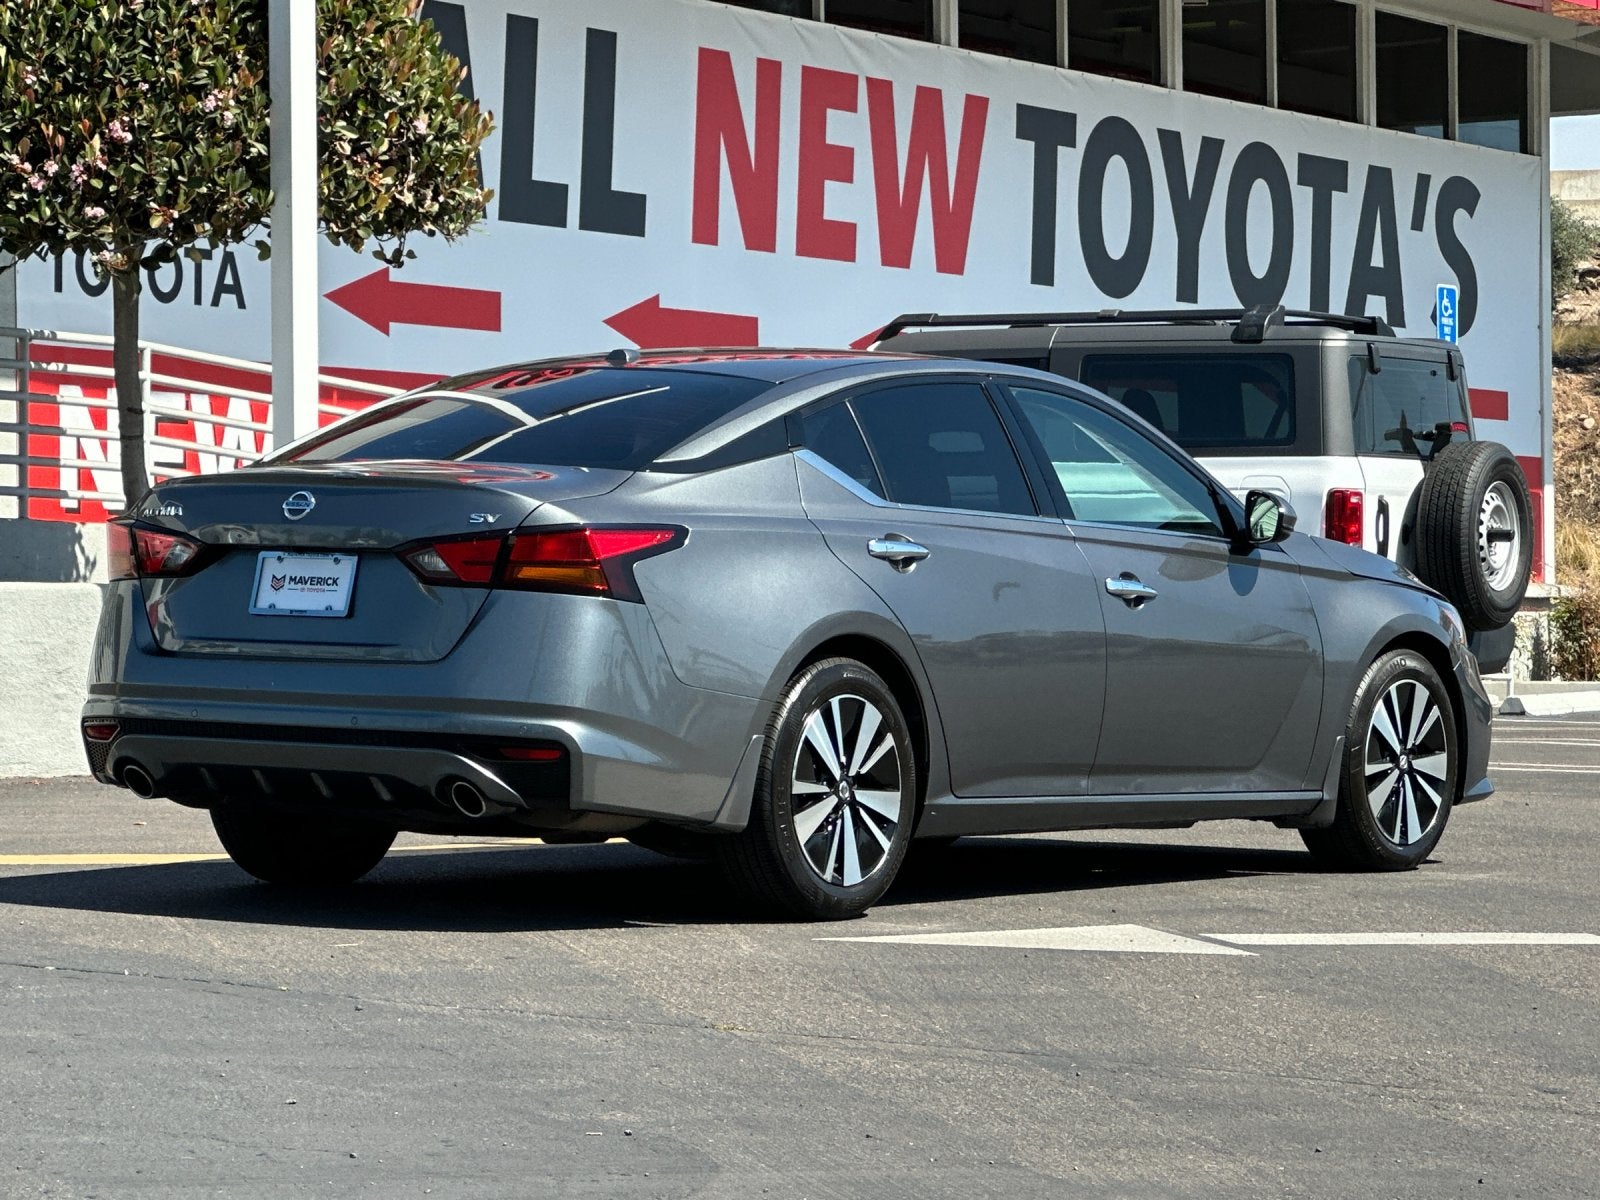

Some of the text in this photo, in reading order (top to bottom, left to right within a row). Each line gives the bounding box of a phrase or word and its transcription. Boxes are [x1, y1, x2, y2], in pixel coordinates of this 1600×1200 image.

[419, 0, 1481, 338] LL NEW TOYOTA'S
[50, 238, 247, 310] OOTA
[469, 513, 502, 523] SV
[288, 575, 340, 587] MAVERICK
